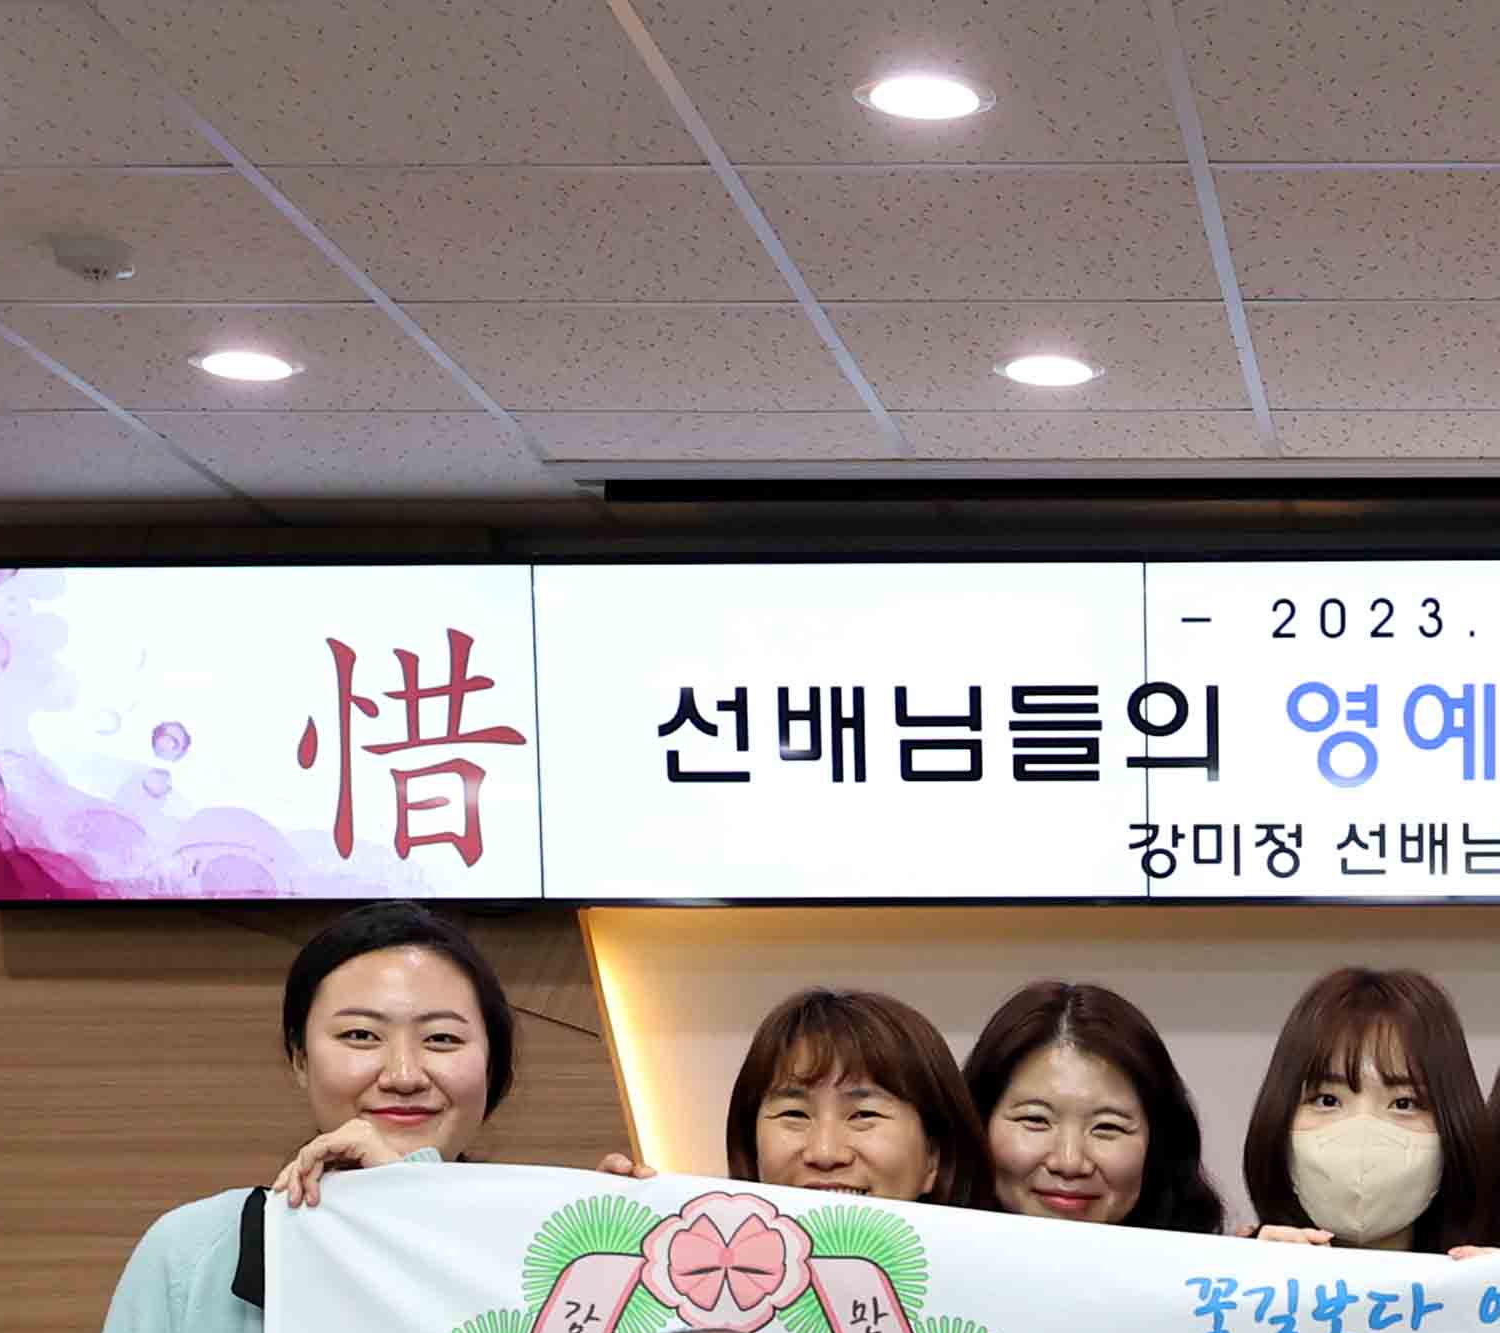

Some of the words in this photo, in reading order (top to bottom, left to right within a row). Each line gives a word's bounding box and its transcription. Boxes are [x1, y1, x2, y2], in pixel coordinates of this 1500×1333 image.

[298, 628, 527, 868] 惜
[657, 680, 1222, 784] 선배님들의
[1127, 821, 1304, 881] 강미정
